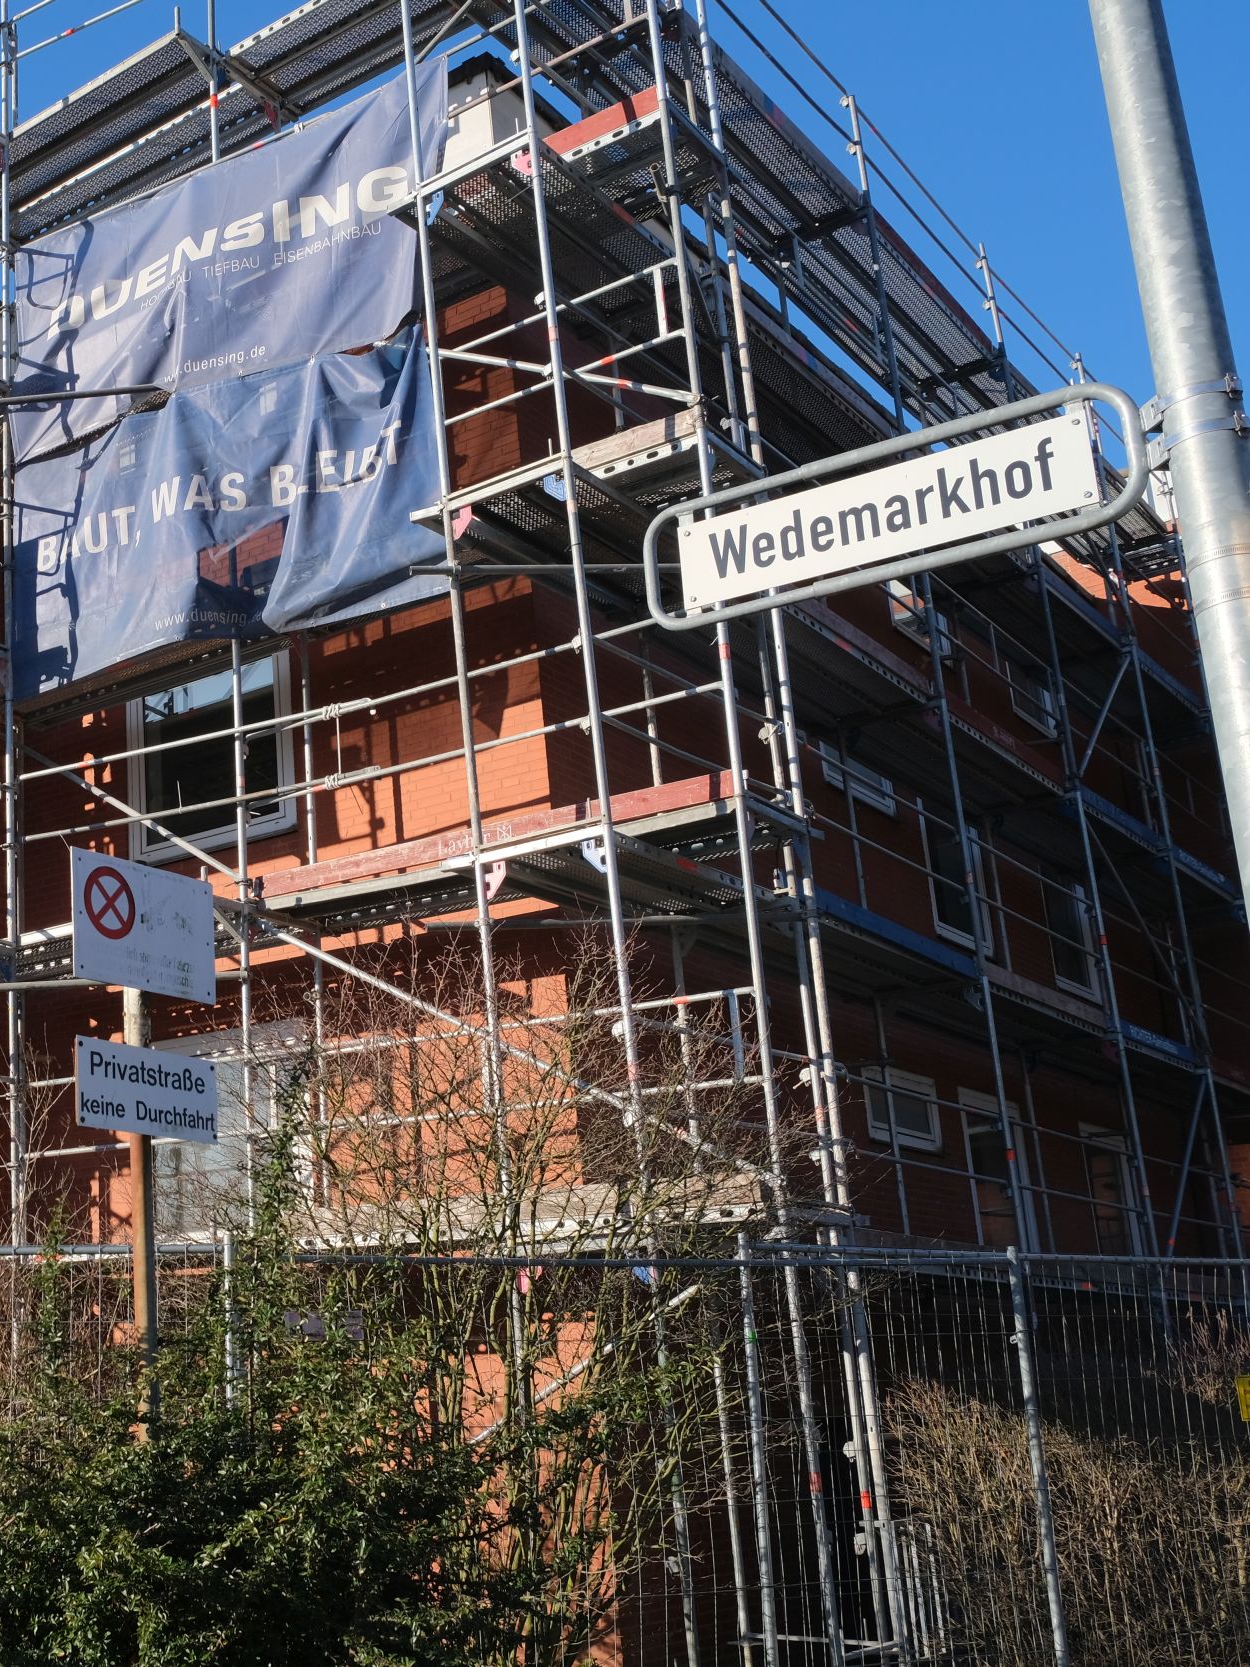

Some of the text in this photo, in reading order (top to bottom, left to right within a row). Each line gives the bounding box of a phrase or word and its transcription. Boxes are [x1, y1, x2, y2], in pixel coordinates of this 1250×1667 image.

[47, 166, 411, 342] DUENSING
[201, 255, 260, 280] TIEFBAU
[273, 221, 383, 267] EISENBAHNBAU
[36, 419, 403, 575] BAUT, WAS BEIBT
[708, 436, 1056, 580] Wedemarkhof
[154, 608, 263, 631] www.duensing.d
[438, 831, 491, 857] Layhr
[89, 1049, 206, 1095] Privatstraße
[80, 1091, 216, 1132] keine Durchfahrt
